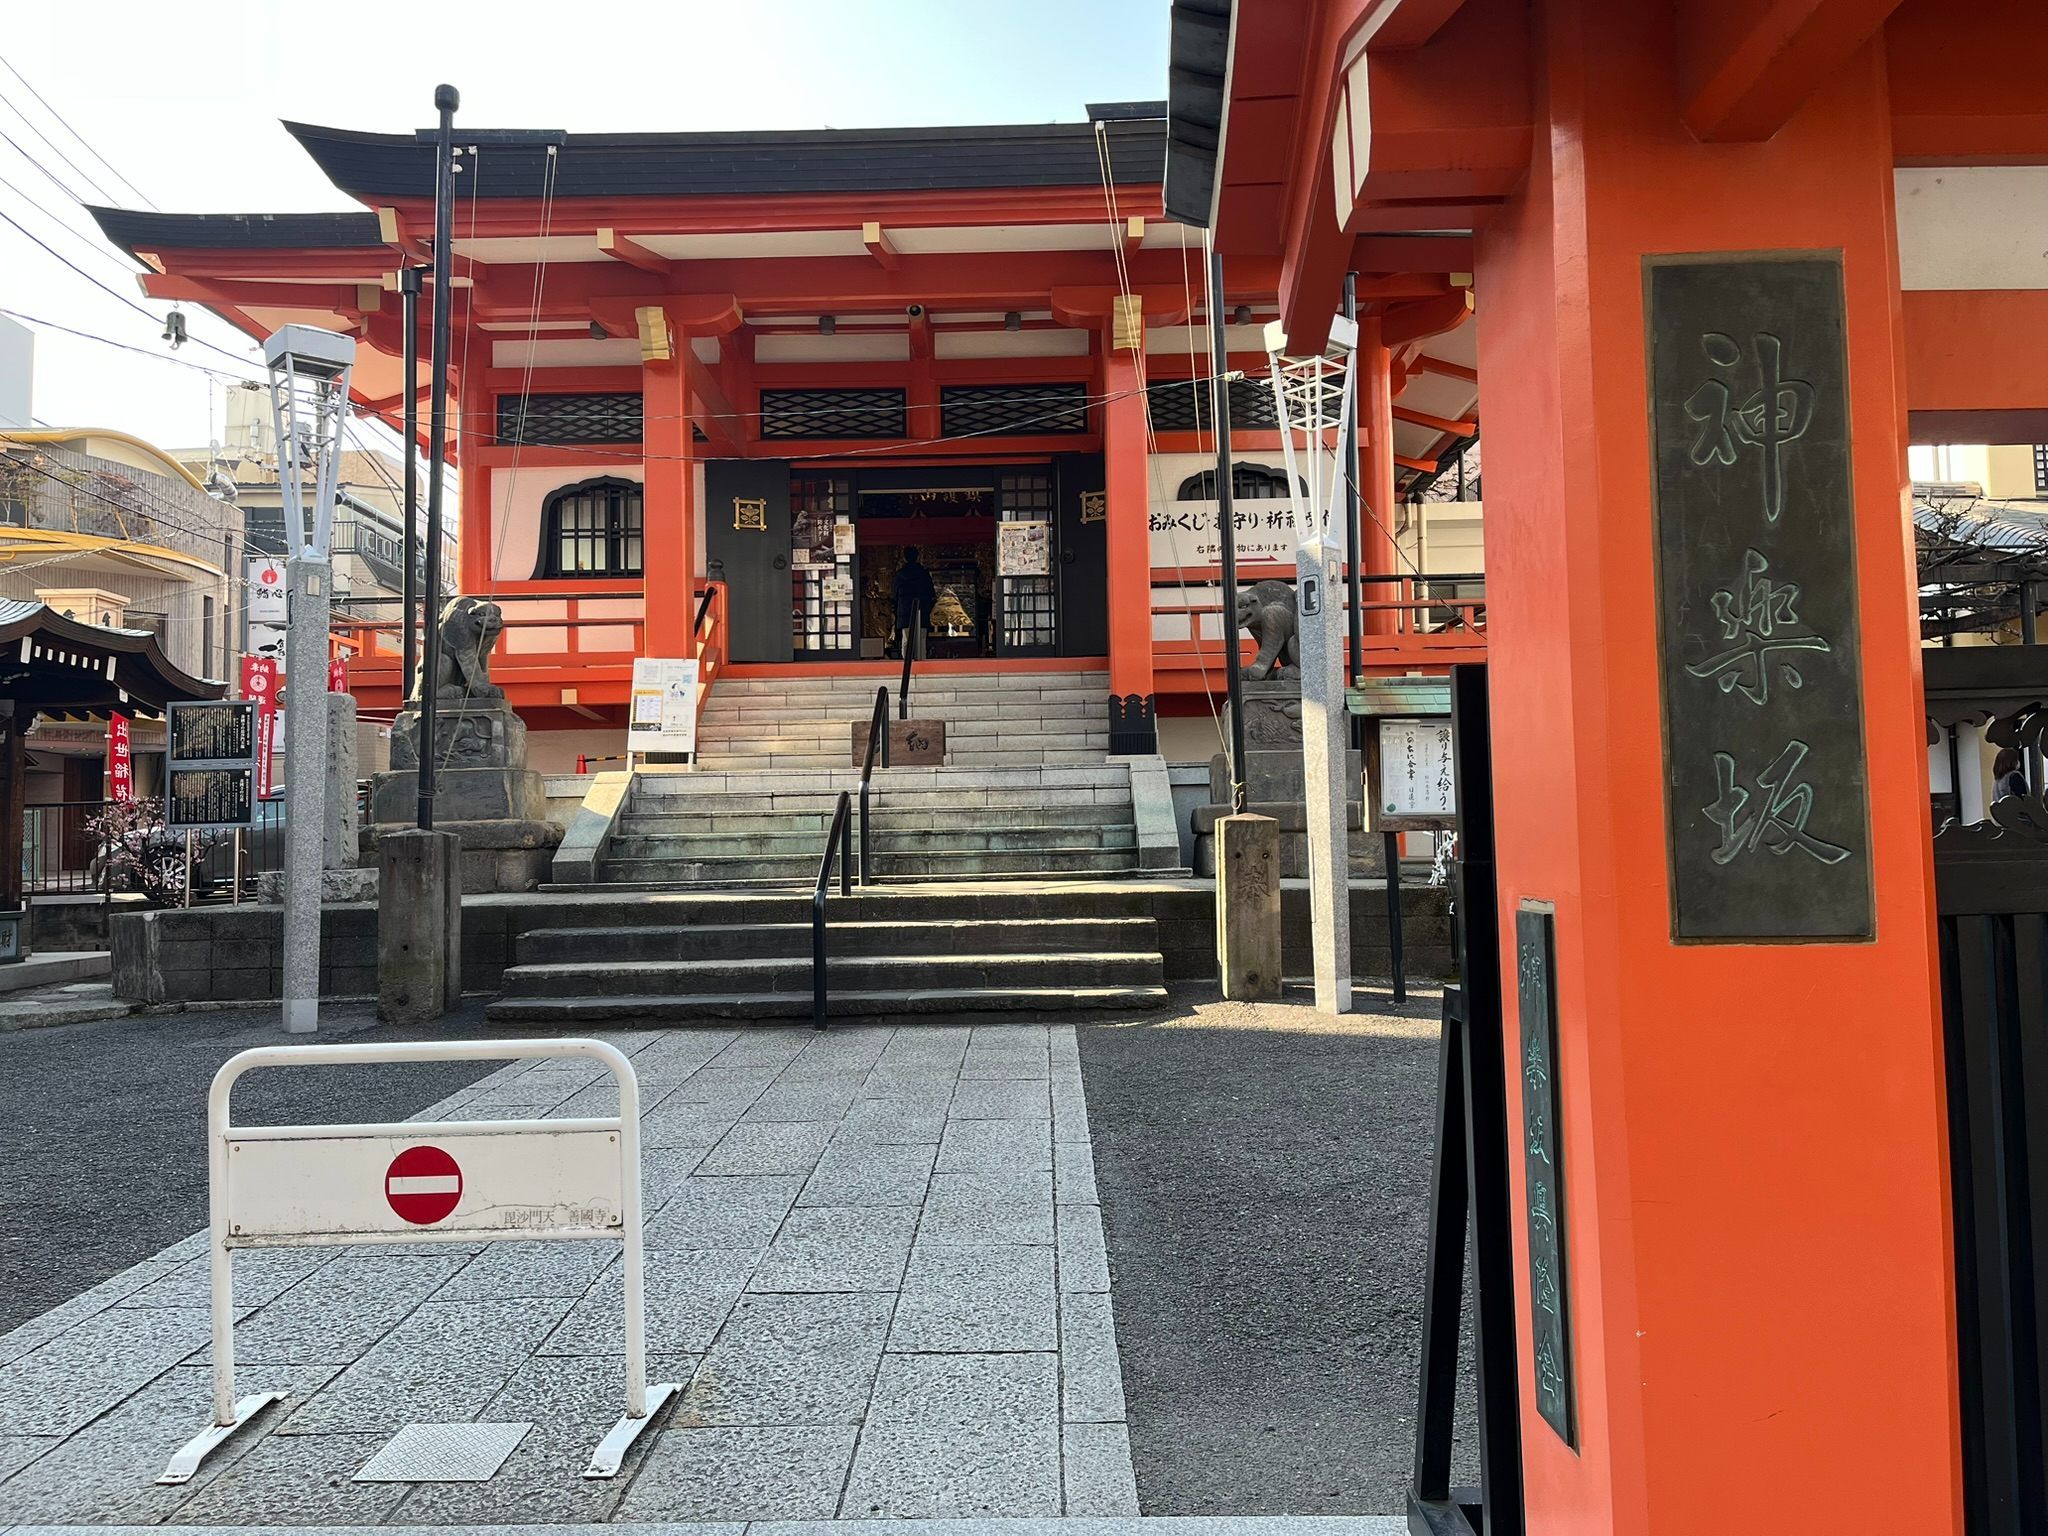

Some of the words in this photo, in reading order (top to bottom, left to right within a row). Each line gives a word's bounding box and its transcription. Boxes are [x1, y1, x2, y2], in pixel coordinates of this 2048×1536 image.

[1196, 543, 1288, 554] 右隣の物にあります
